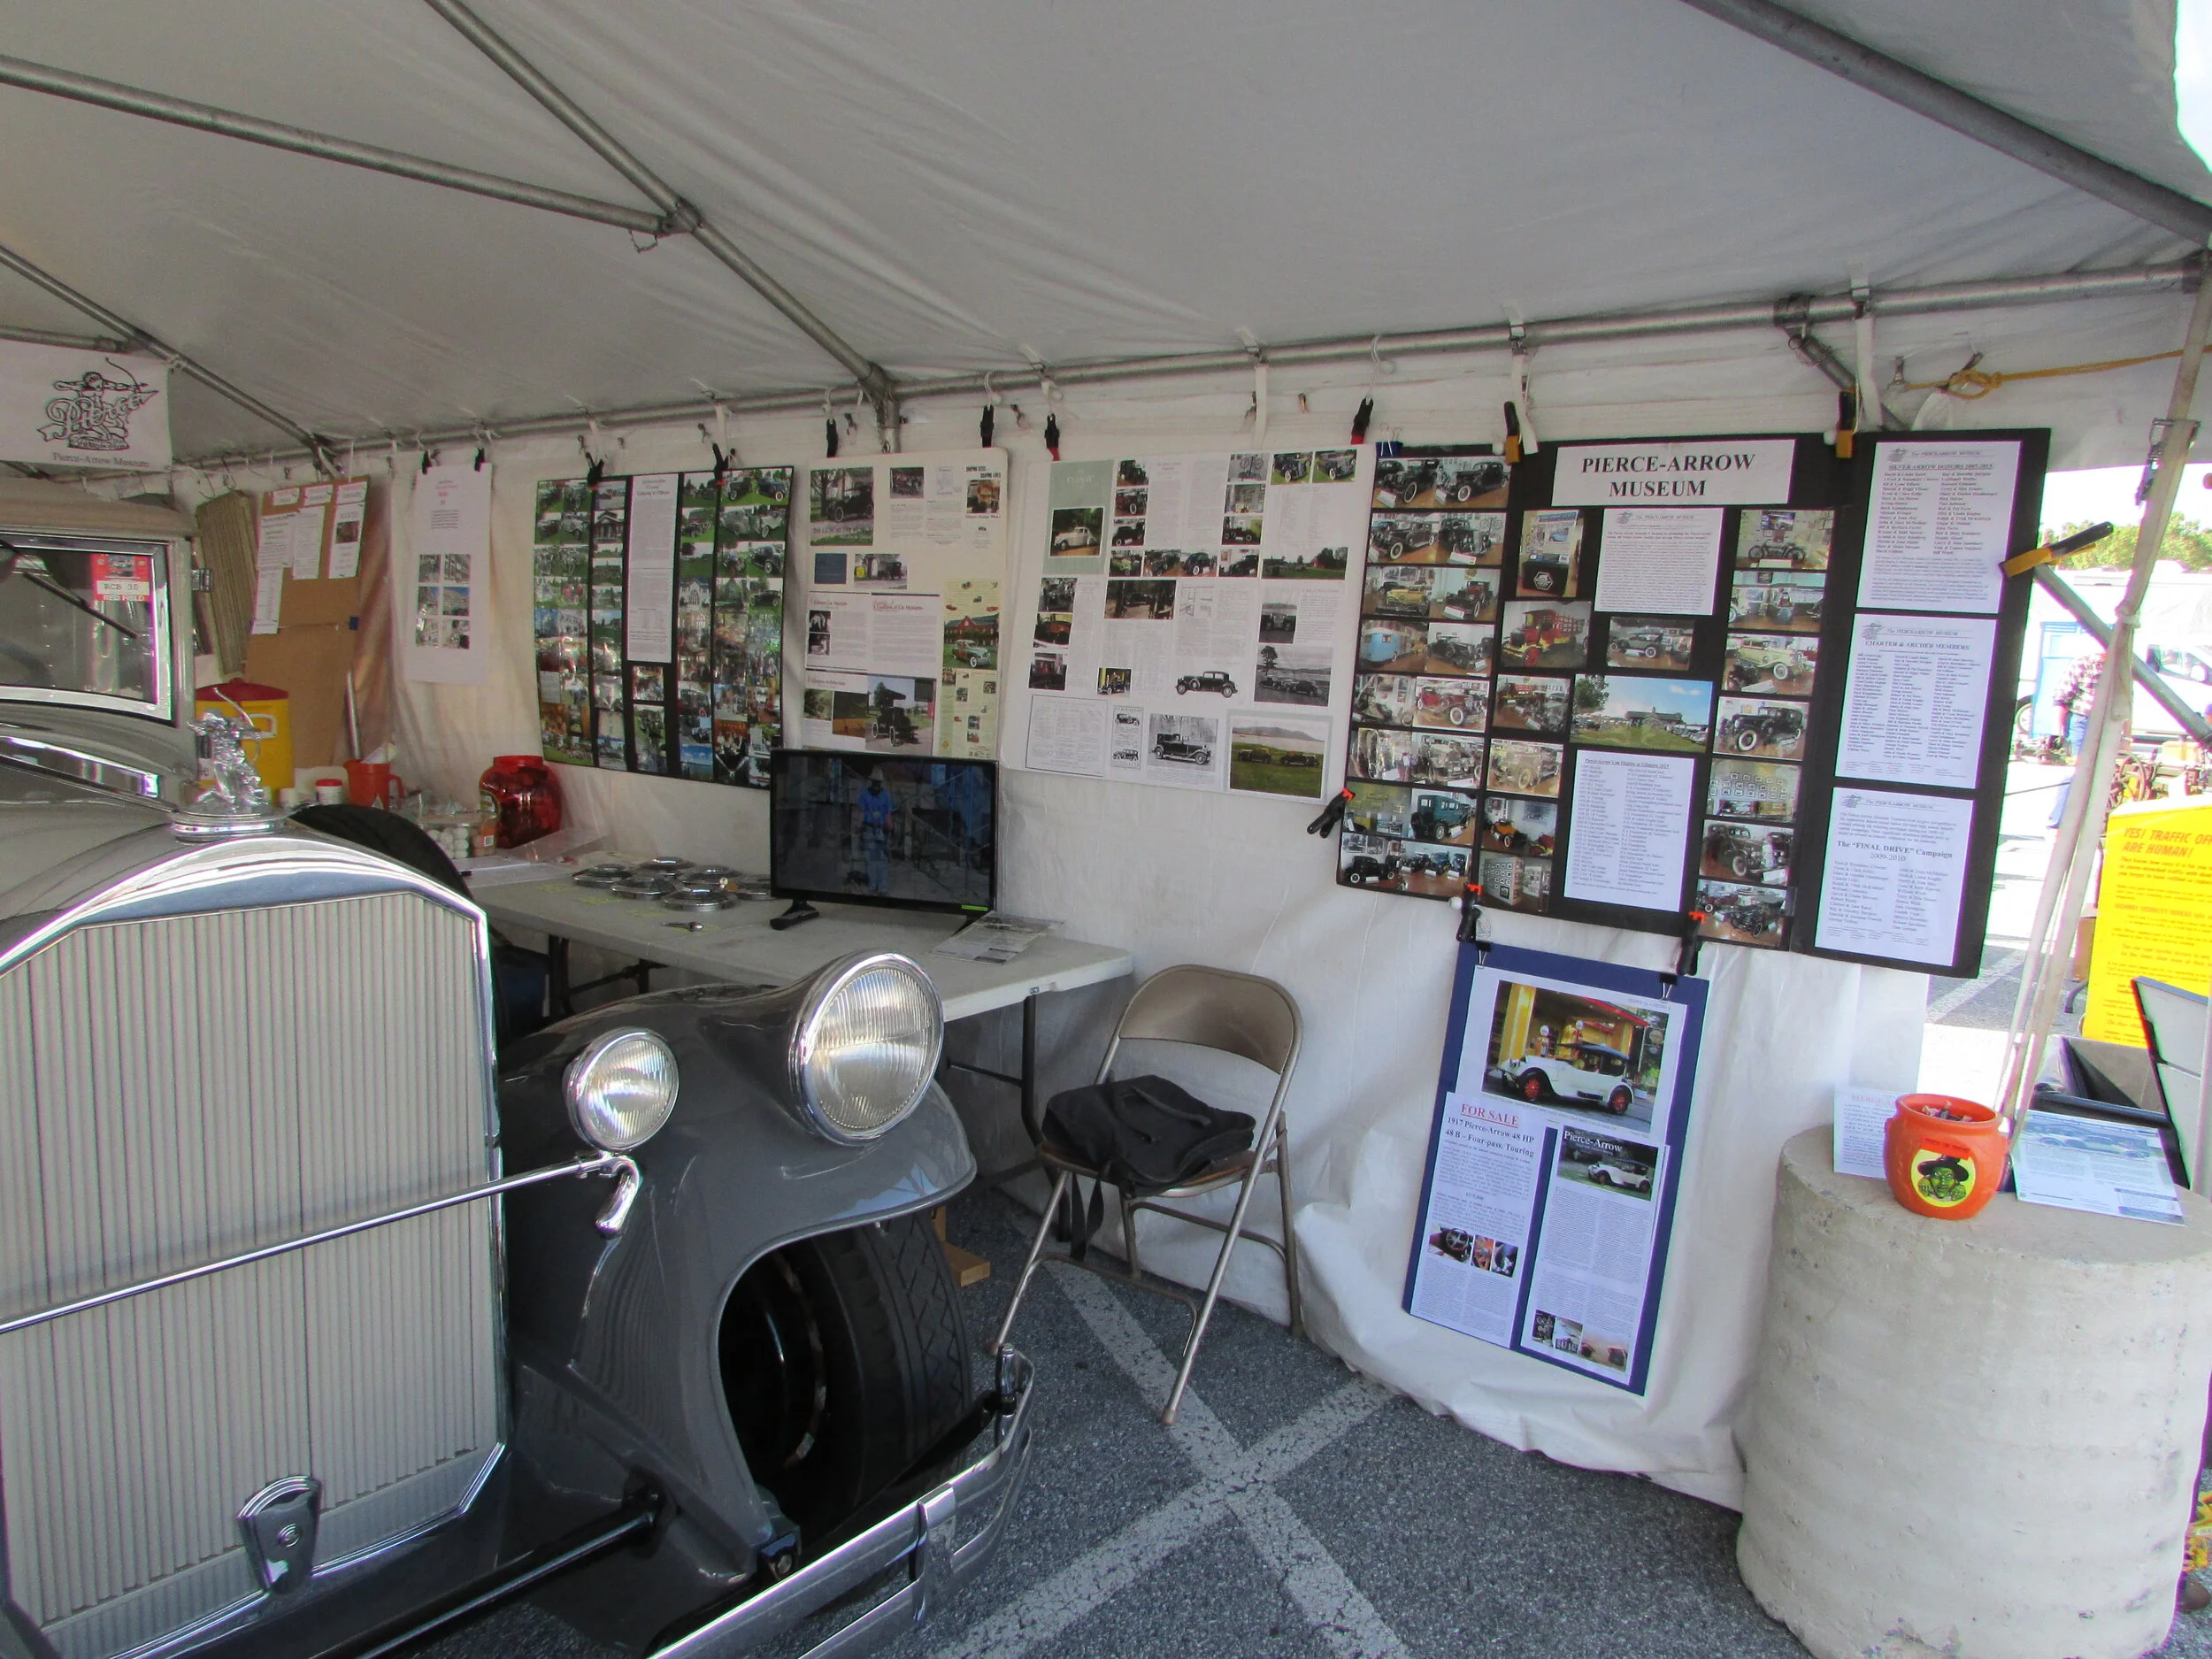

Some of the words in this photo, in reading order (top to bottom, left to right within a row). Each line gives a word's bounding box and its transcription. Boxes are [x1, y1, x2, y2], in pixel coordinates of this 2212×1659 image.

[53, 452, 111, 464] Pierce-Arrow
[113, 457, 150, 467] Museum
[1582, 453, 1755, 473] PIERCE-ARROW
[1609, 480, 1707, 497] MUSEUM
[2124, 827, 2147, 840] YES!
[2149, 829, 2193, 844] TRAFFIC
[1869, 852, 1906, 862] 2009-2010
[1916, 849, 1953, 858] Campaign
[2122, 841, 2145, 853] ARE
[2146, 843, 2194, 858] HUMAN!
[1461, 1103, 1486, 1118] FOR
[1488, 1110, 1519, 1126] SALE
[1448, 1117, 1463, 1126] 1917
[1464, 1120, 1510, 1138] Pierce-Arrow
[1512, 1133, 1521, 1141] 48
[1522, 1134, 1534, 1144] HP
[1563, 1130, 1623, 1152] Pierce-Arrow
[1506, 1143, 1535, 1158] Touring
